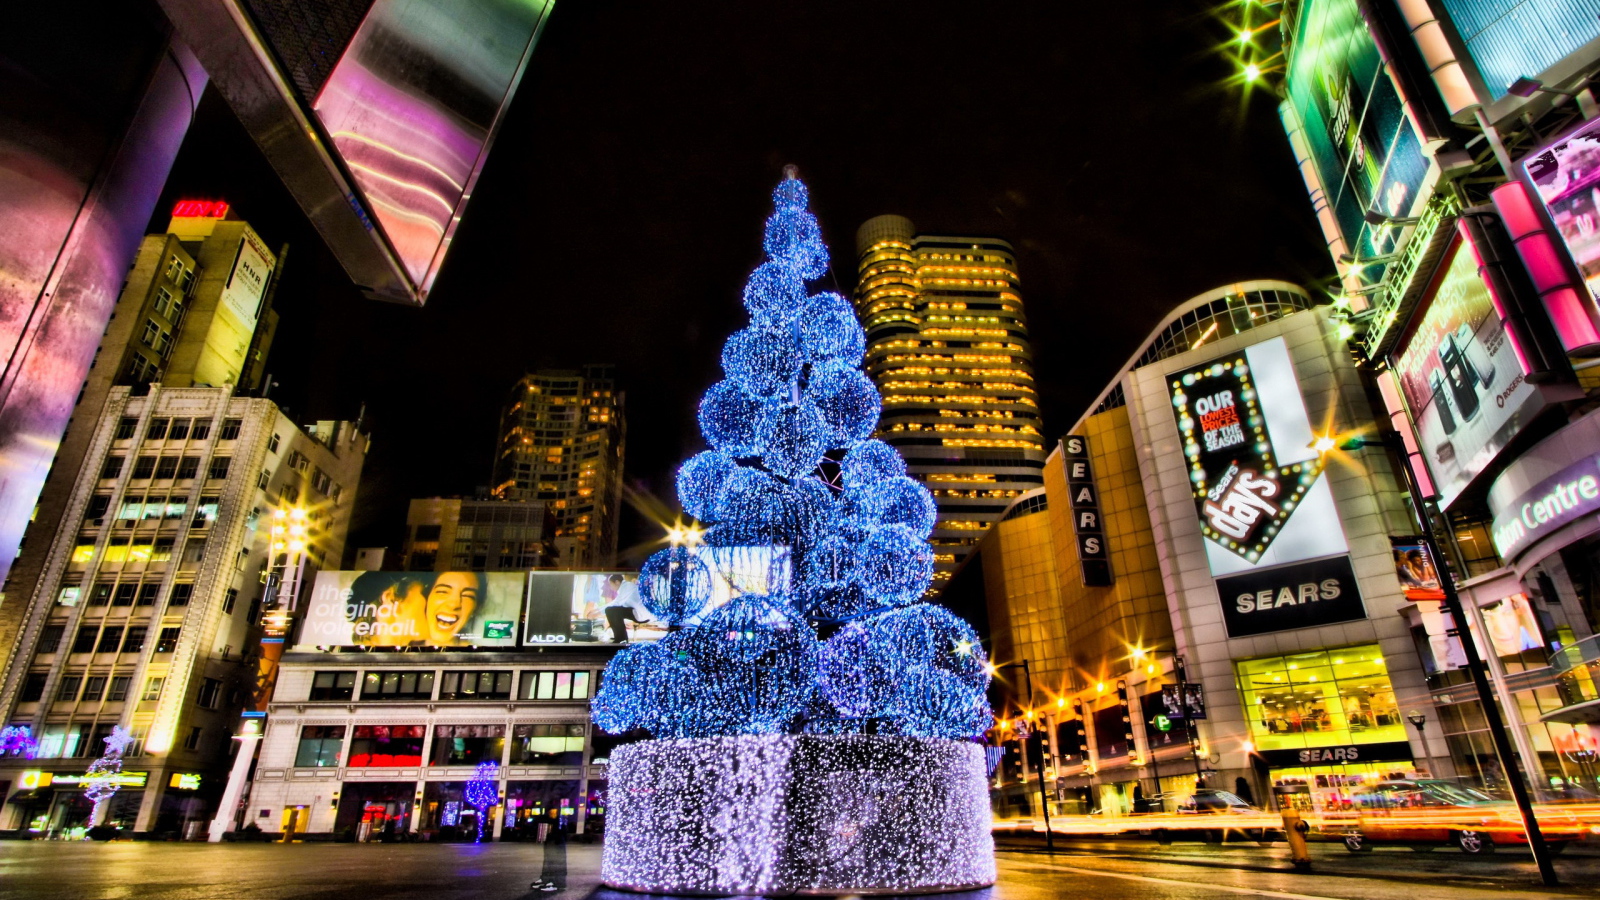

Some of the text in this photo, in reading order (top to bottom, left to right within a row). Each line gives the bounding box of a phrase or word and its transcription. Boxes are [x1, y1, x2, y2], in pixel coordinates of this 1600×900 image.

[243, 261, 261, 285] HNR
[1503, 374, 1524, 399] ROGERS
[1195, 390, 1235, 416] OUR
[1200, 405, 1236, 424] LOWEST
[1202, 414, 1239, 433] PRICES
[1204, 424, 1240, 442] OF THE
[1206, 432, 1245, 452] SEASON
[1208, 465, 1239, 501] Sears
[1067, 438, 1100, 554] SEARS
[1206, 472, 1277, 538] days
[1522, 475, 1599, 529] Centre
[1418, 539, 1429, 568] DINING
[319, 584, 353, 601] the
[1236, 578, 1341, 613] SEARS
[315, 600, 399, 621] original
[312, 618, 419, 637] voicemail.
[530, 634, 566, 643] ALDO
[1157, 716, 1170, 728] P
[1299, 747, 1359, 763] SEARS
